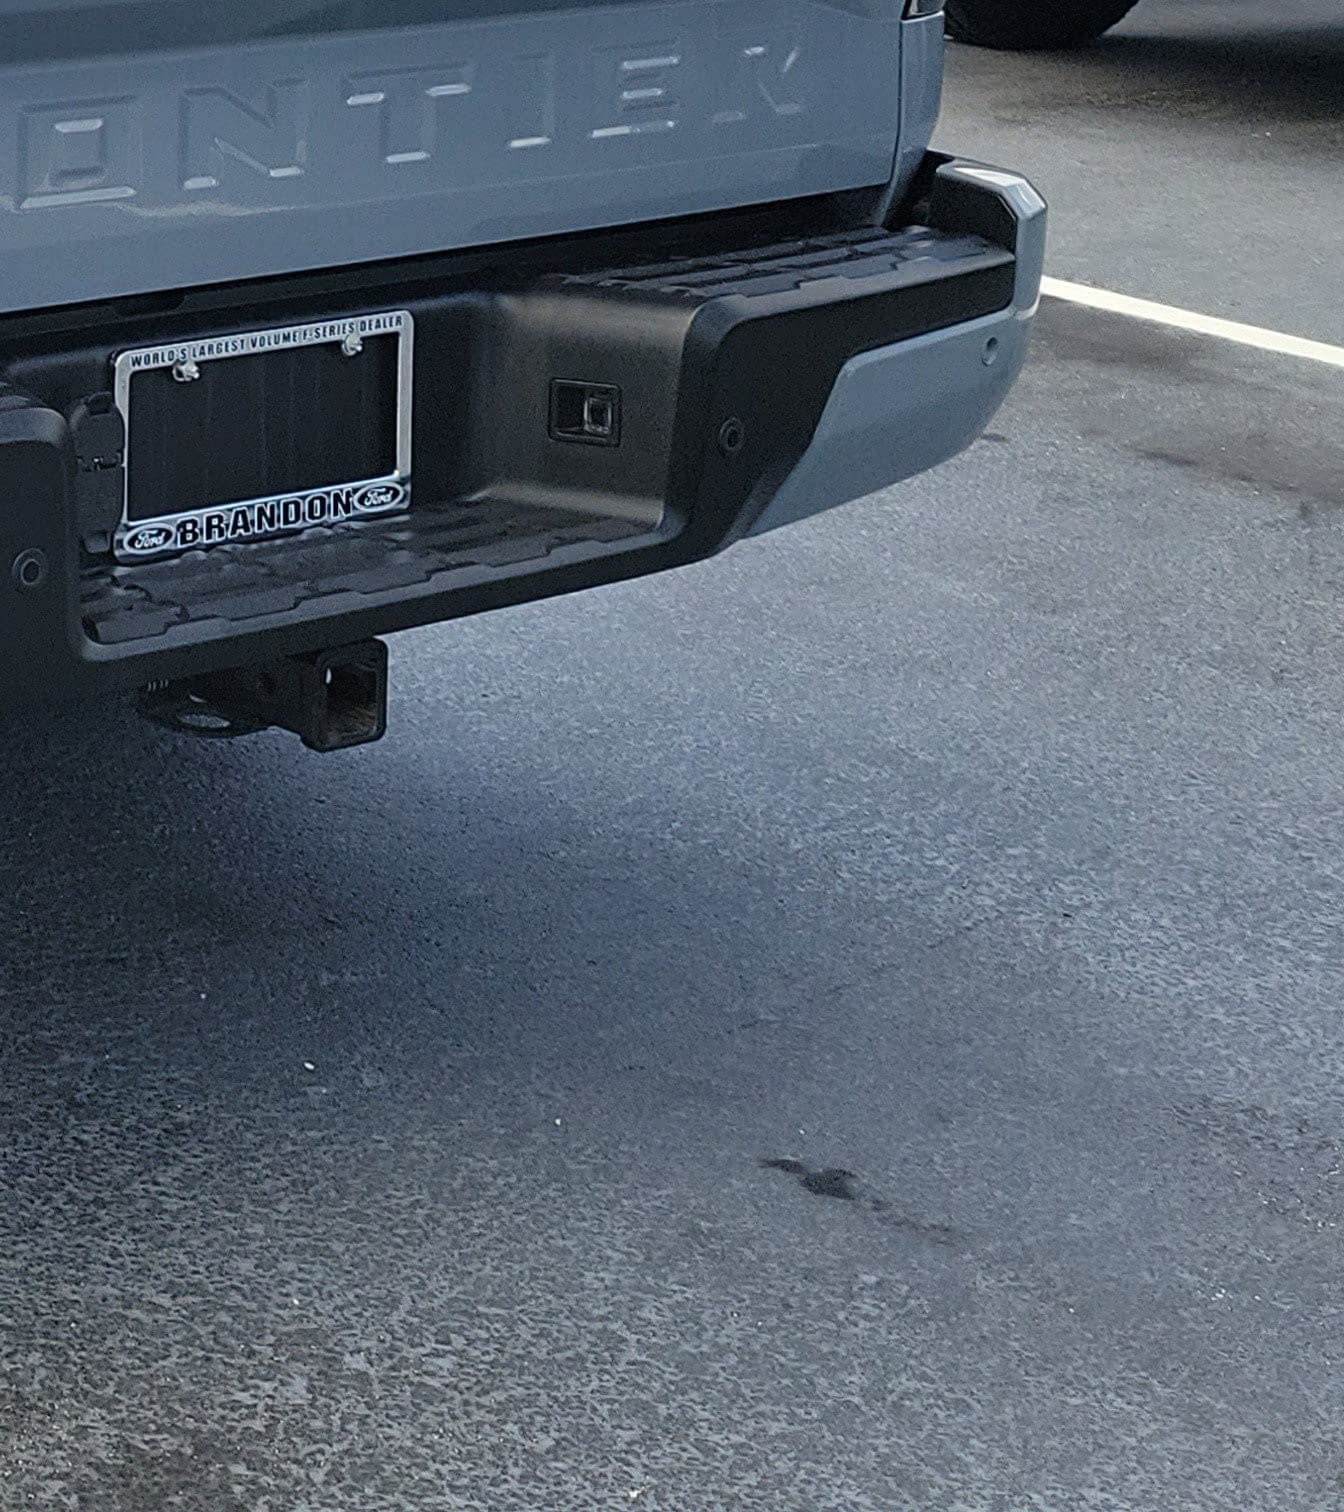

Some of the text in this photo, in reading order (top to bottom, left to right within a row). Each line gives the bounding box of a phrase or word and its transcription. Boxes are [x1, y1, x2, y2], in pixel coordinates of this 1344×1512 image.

[131, 315, 404, 368] WORLD'S LARGEST VOLUME F-SERIES DEALER
[177, 488, 354, 548] BRANDON
